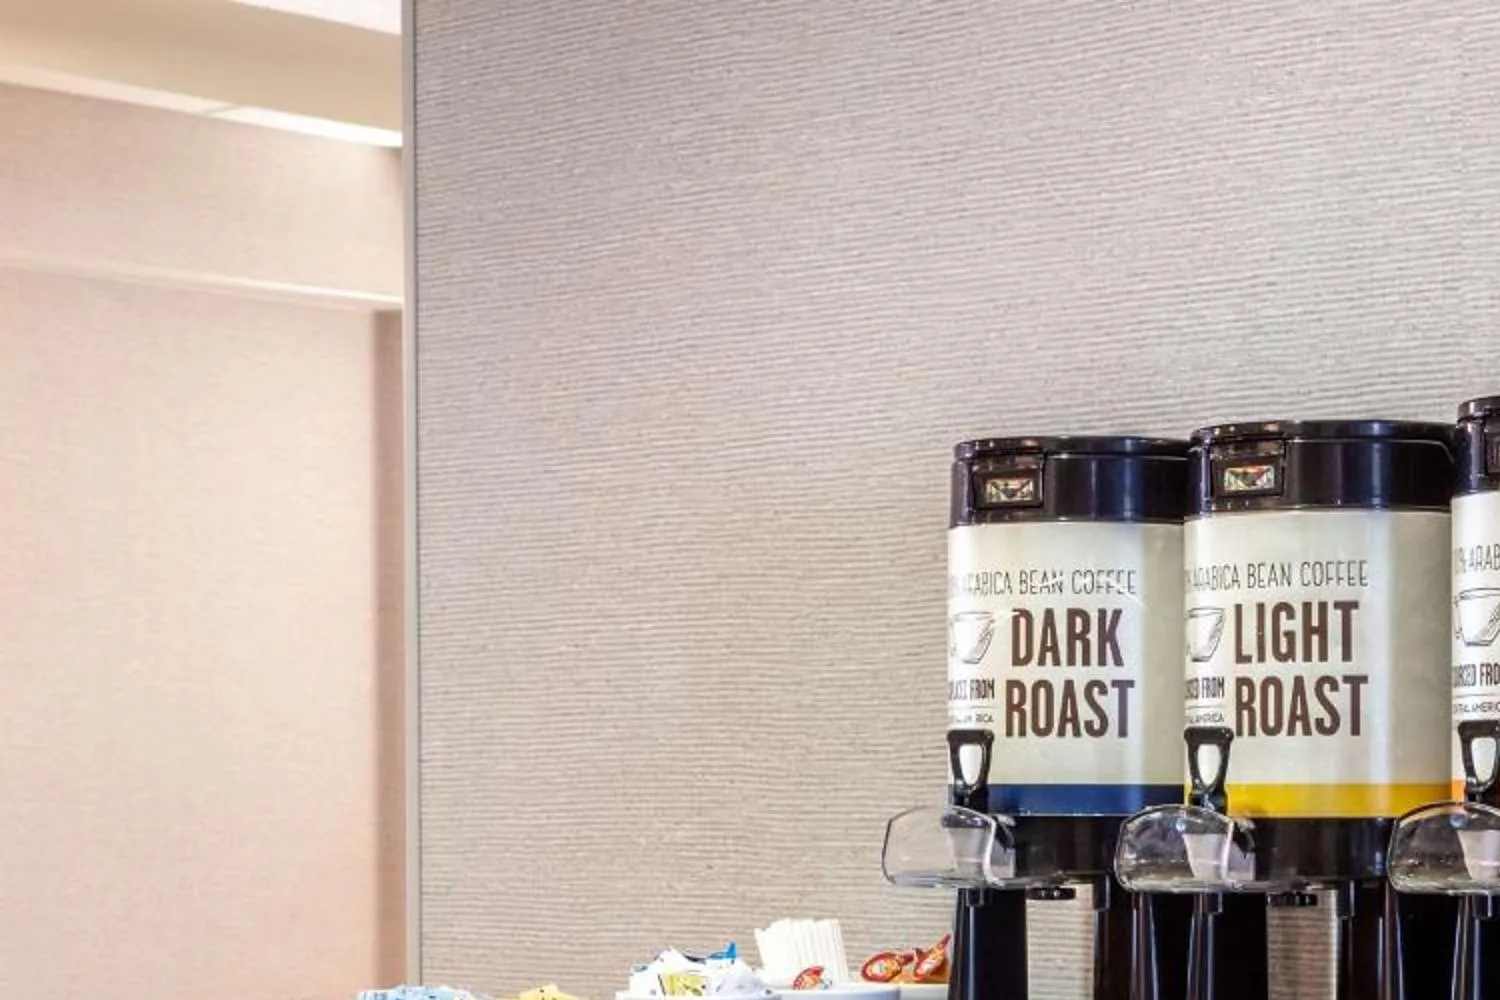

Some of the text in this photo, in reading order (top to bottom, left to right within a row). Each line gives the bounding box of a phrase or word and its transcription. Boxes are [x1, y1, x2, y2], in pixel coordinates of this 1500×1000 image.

[1019, 570, 1064, 595] BEAN
[1072, 569, 1137, 595] COFFEE
[1247, 562, 1292, 589] BEAN
[1300, 560, 1369, 587] COFFEE
[1010, 607, 1125, 667] DARK
[1234, 600, 1360, 664] LIGHT
[1005, 679, 1136, 738] ROAST
[1202, 676, 1225, 699] FROM
[1235, 674, 1369, 737] ROAST
